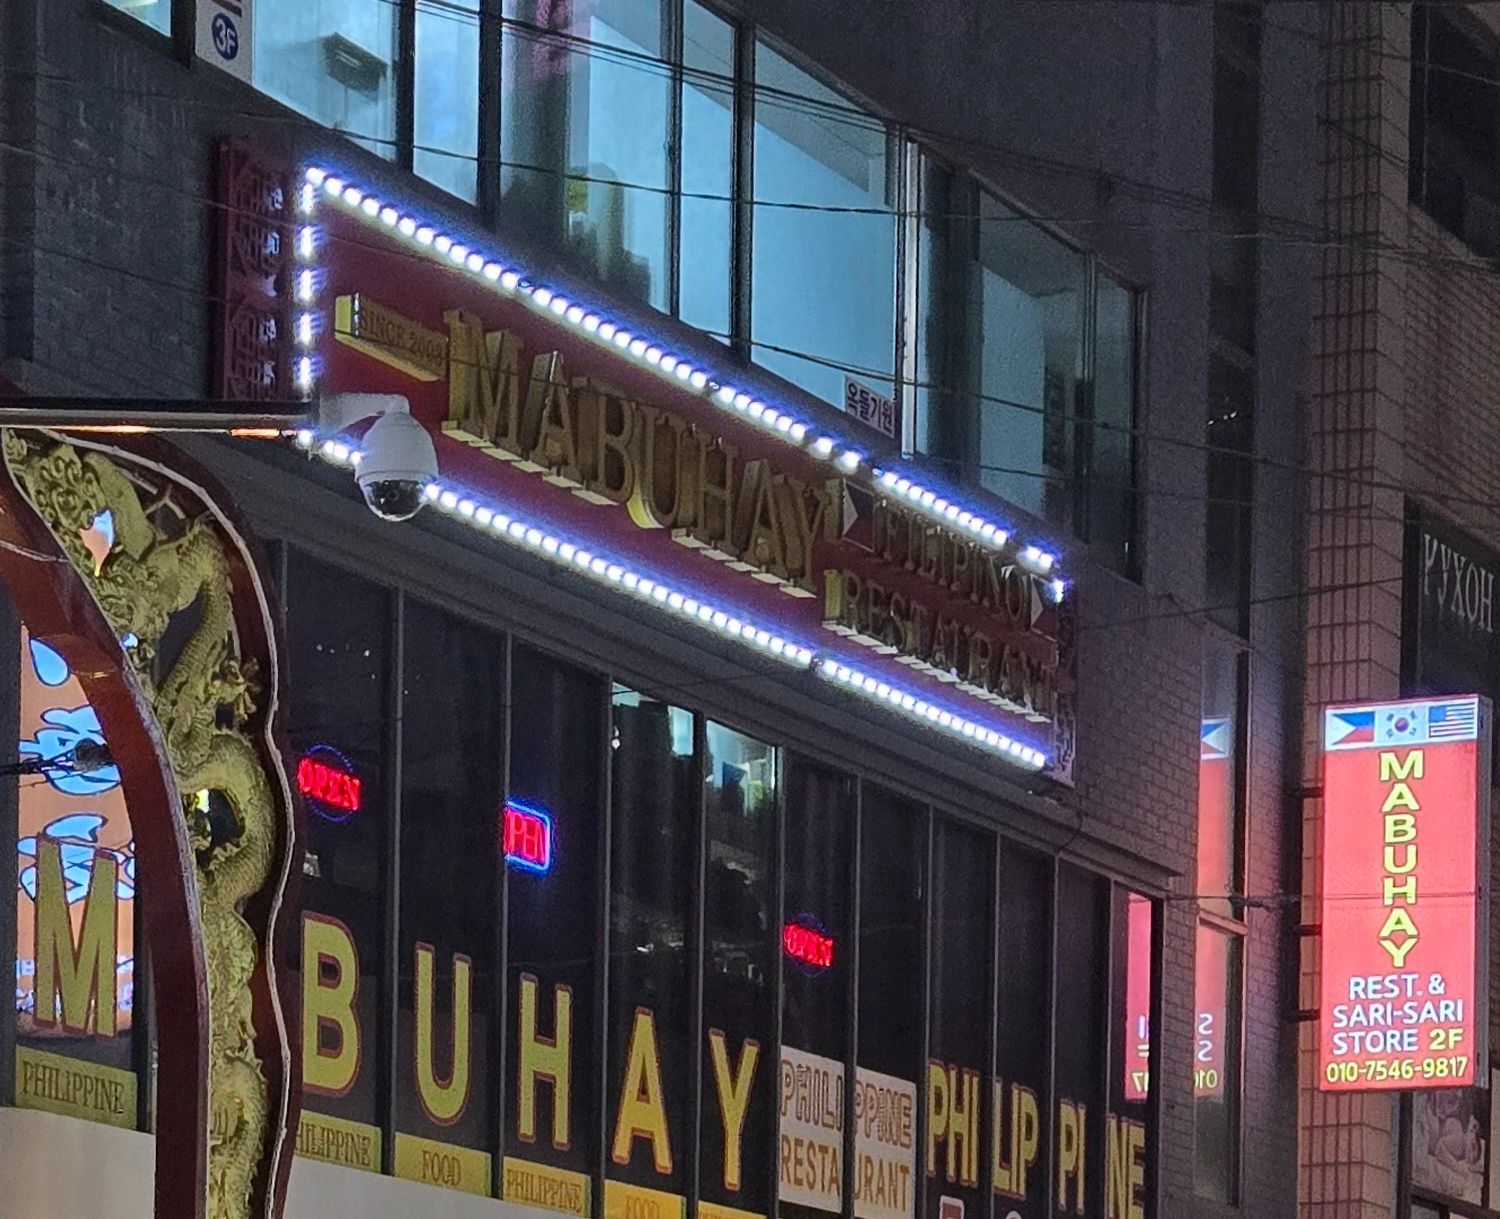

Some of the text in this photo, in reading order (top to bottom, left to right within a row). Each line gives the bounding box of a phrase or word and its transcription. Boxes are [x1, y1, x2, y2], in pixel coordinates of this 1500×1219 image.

[216, 18, 236, 54] 3F
[442, 308, 844, 598] MABUHAY
[298, 757, 362, 812] OPEN
[1379, 749, 1425, 968] MABUHAY
[1349, 973, 1446, 1000] REST. &
[1332, 998, 1464, 1029] SARI-SARI
[1332, 1027, 1465, 1056] STORE 2F
[21, 1060, 126, 1115] PHILIPPINE
[1325, 1055, 1469, 1084] 010-7546-9817
[297, 1120, 372, 1168] HILIPPINE
[421, 1148, 462, 1188] FOOD
